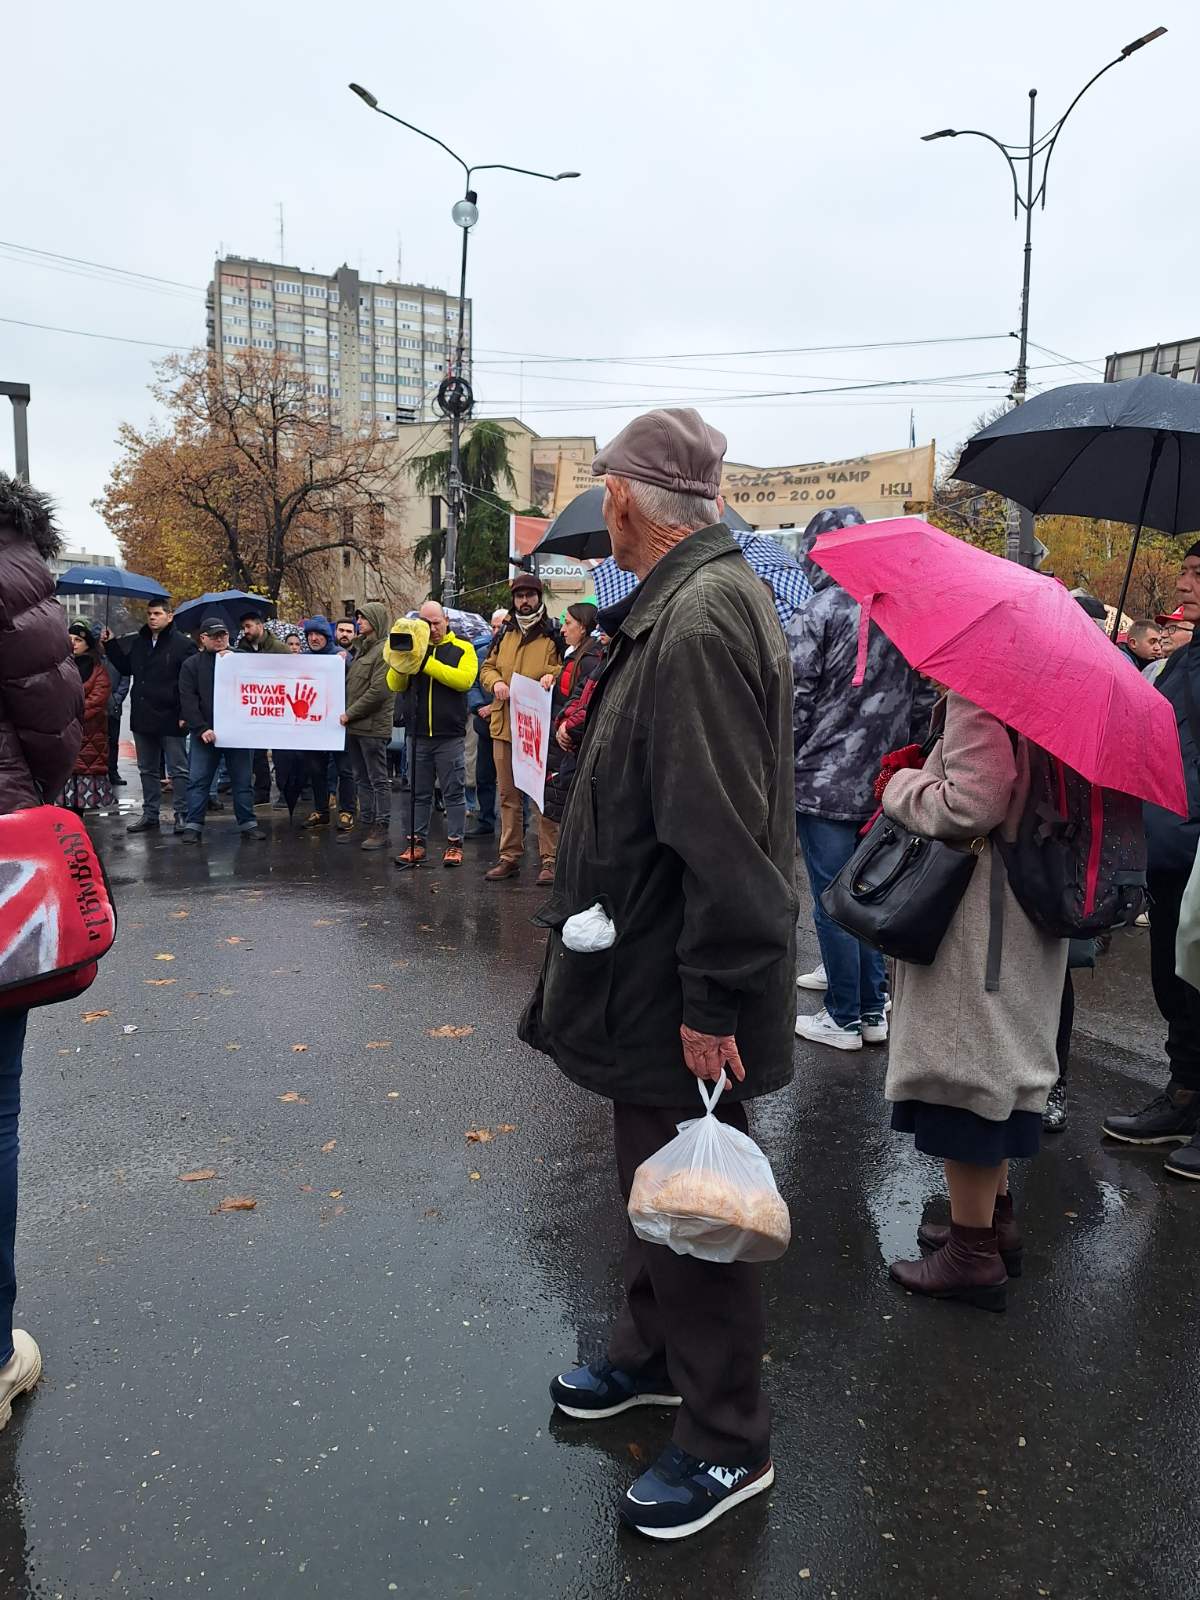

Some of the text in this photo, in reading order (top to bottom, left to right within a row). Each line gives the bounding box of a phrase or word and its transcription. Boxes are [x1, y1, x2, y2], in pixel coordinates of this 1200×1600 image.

[827, 470, 871, 483] ЧАИР
[241, 683, 286, 695] KRVAVE
[242, 695, 286, 706] SU VAM
[250, 706, 285, 717] RUKE!
